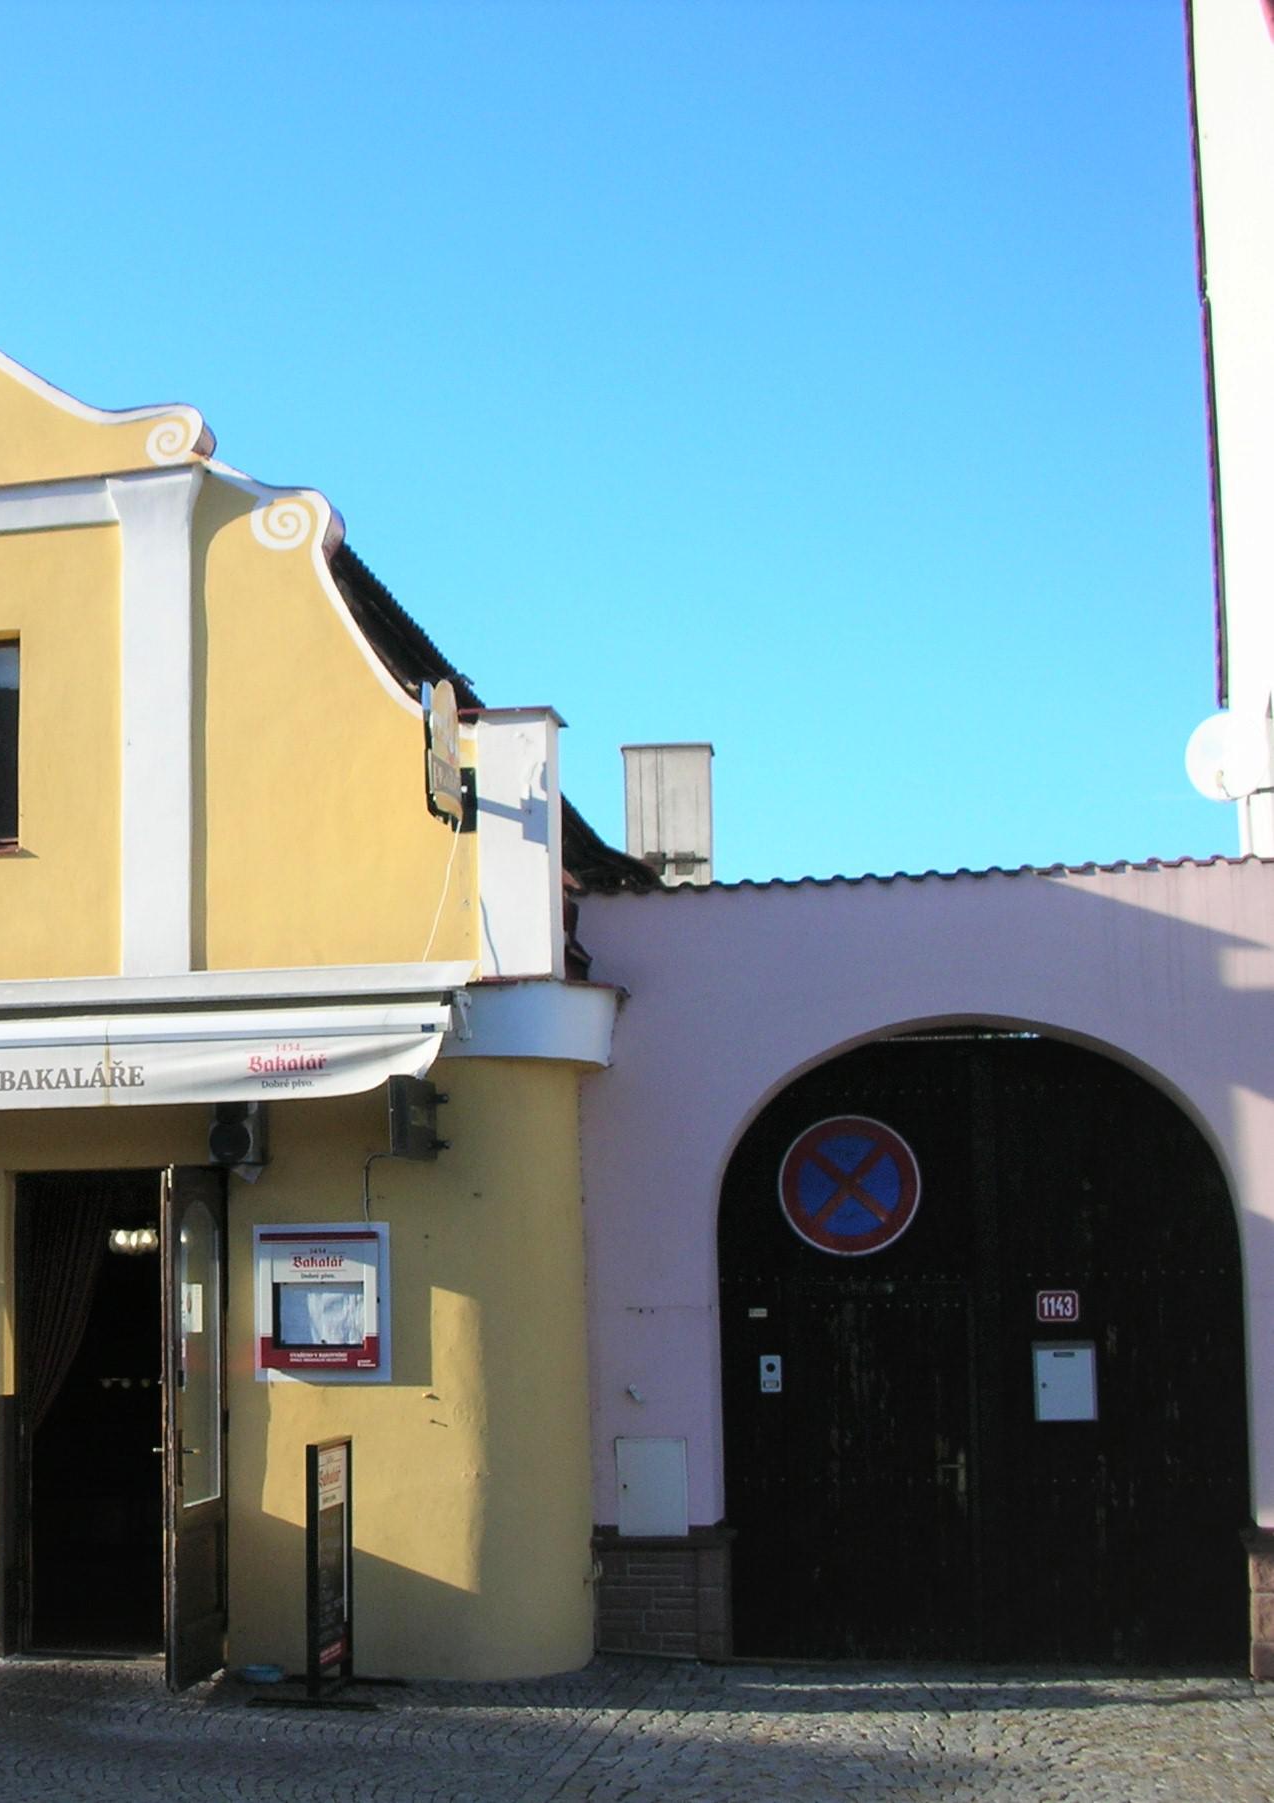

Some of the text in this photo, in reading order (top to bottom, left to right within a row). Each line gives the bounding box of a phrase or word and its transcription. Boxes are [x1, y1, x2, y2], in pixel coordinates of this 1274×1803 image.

[247, 1054, 327, 1073] Bakalář
[293, 1255, 344, 1268] Bakalář
[1041, 1296, 1073, 1317] 1143
